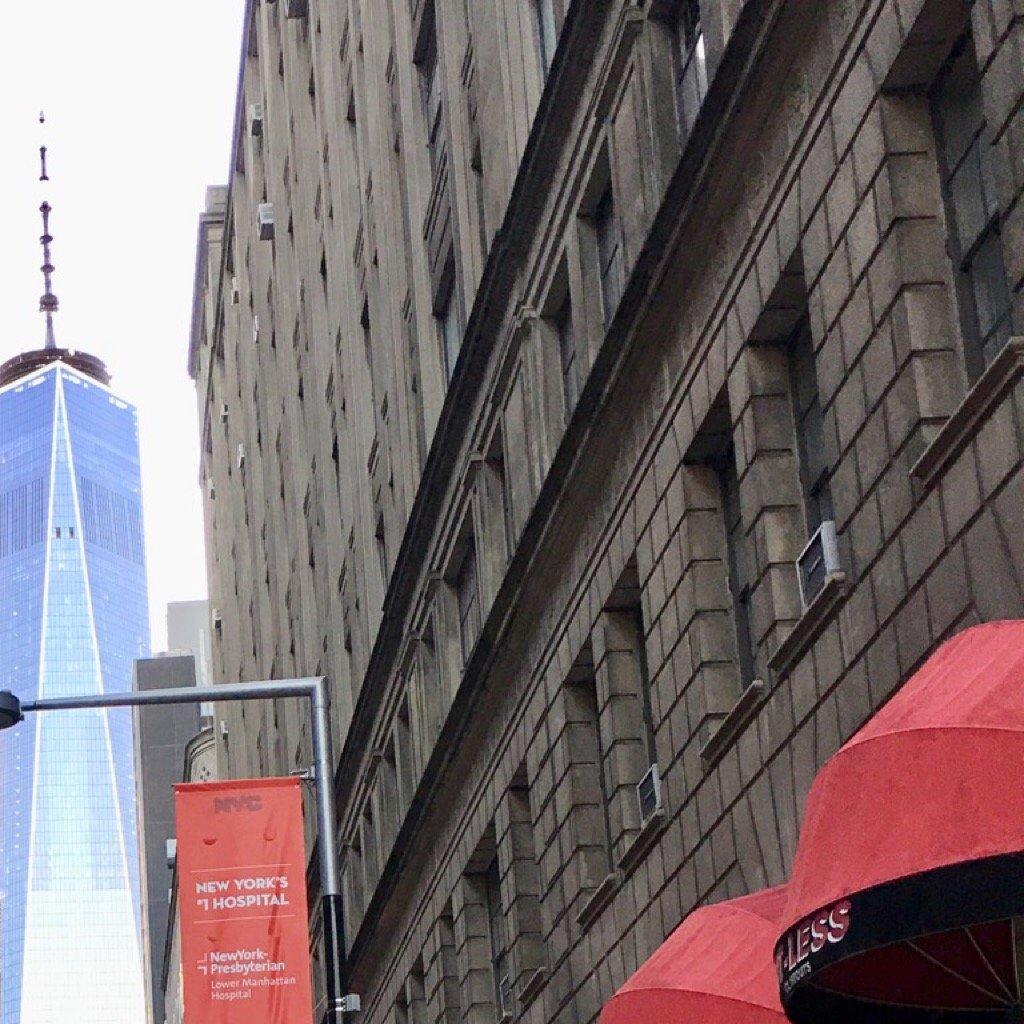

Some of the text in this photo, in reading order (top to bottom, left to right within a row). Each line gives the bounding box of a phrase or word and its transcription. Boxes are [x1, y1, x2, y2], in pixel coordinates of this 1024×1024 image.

[196, 876, 289, 893] NEW YORK'S
[212, 893, 290, 909] HOSPITAL
[211, 960, 285, 975] Presbyterian
[211, 976, 296, 989] Lower Manhattan
[211, 989, 252, 1001] Hospital
